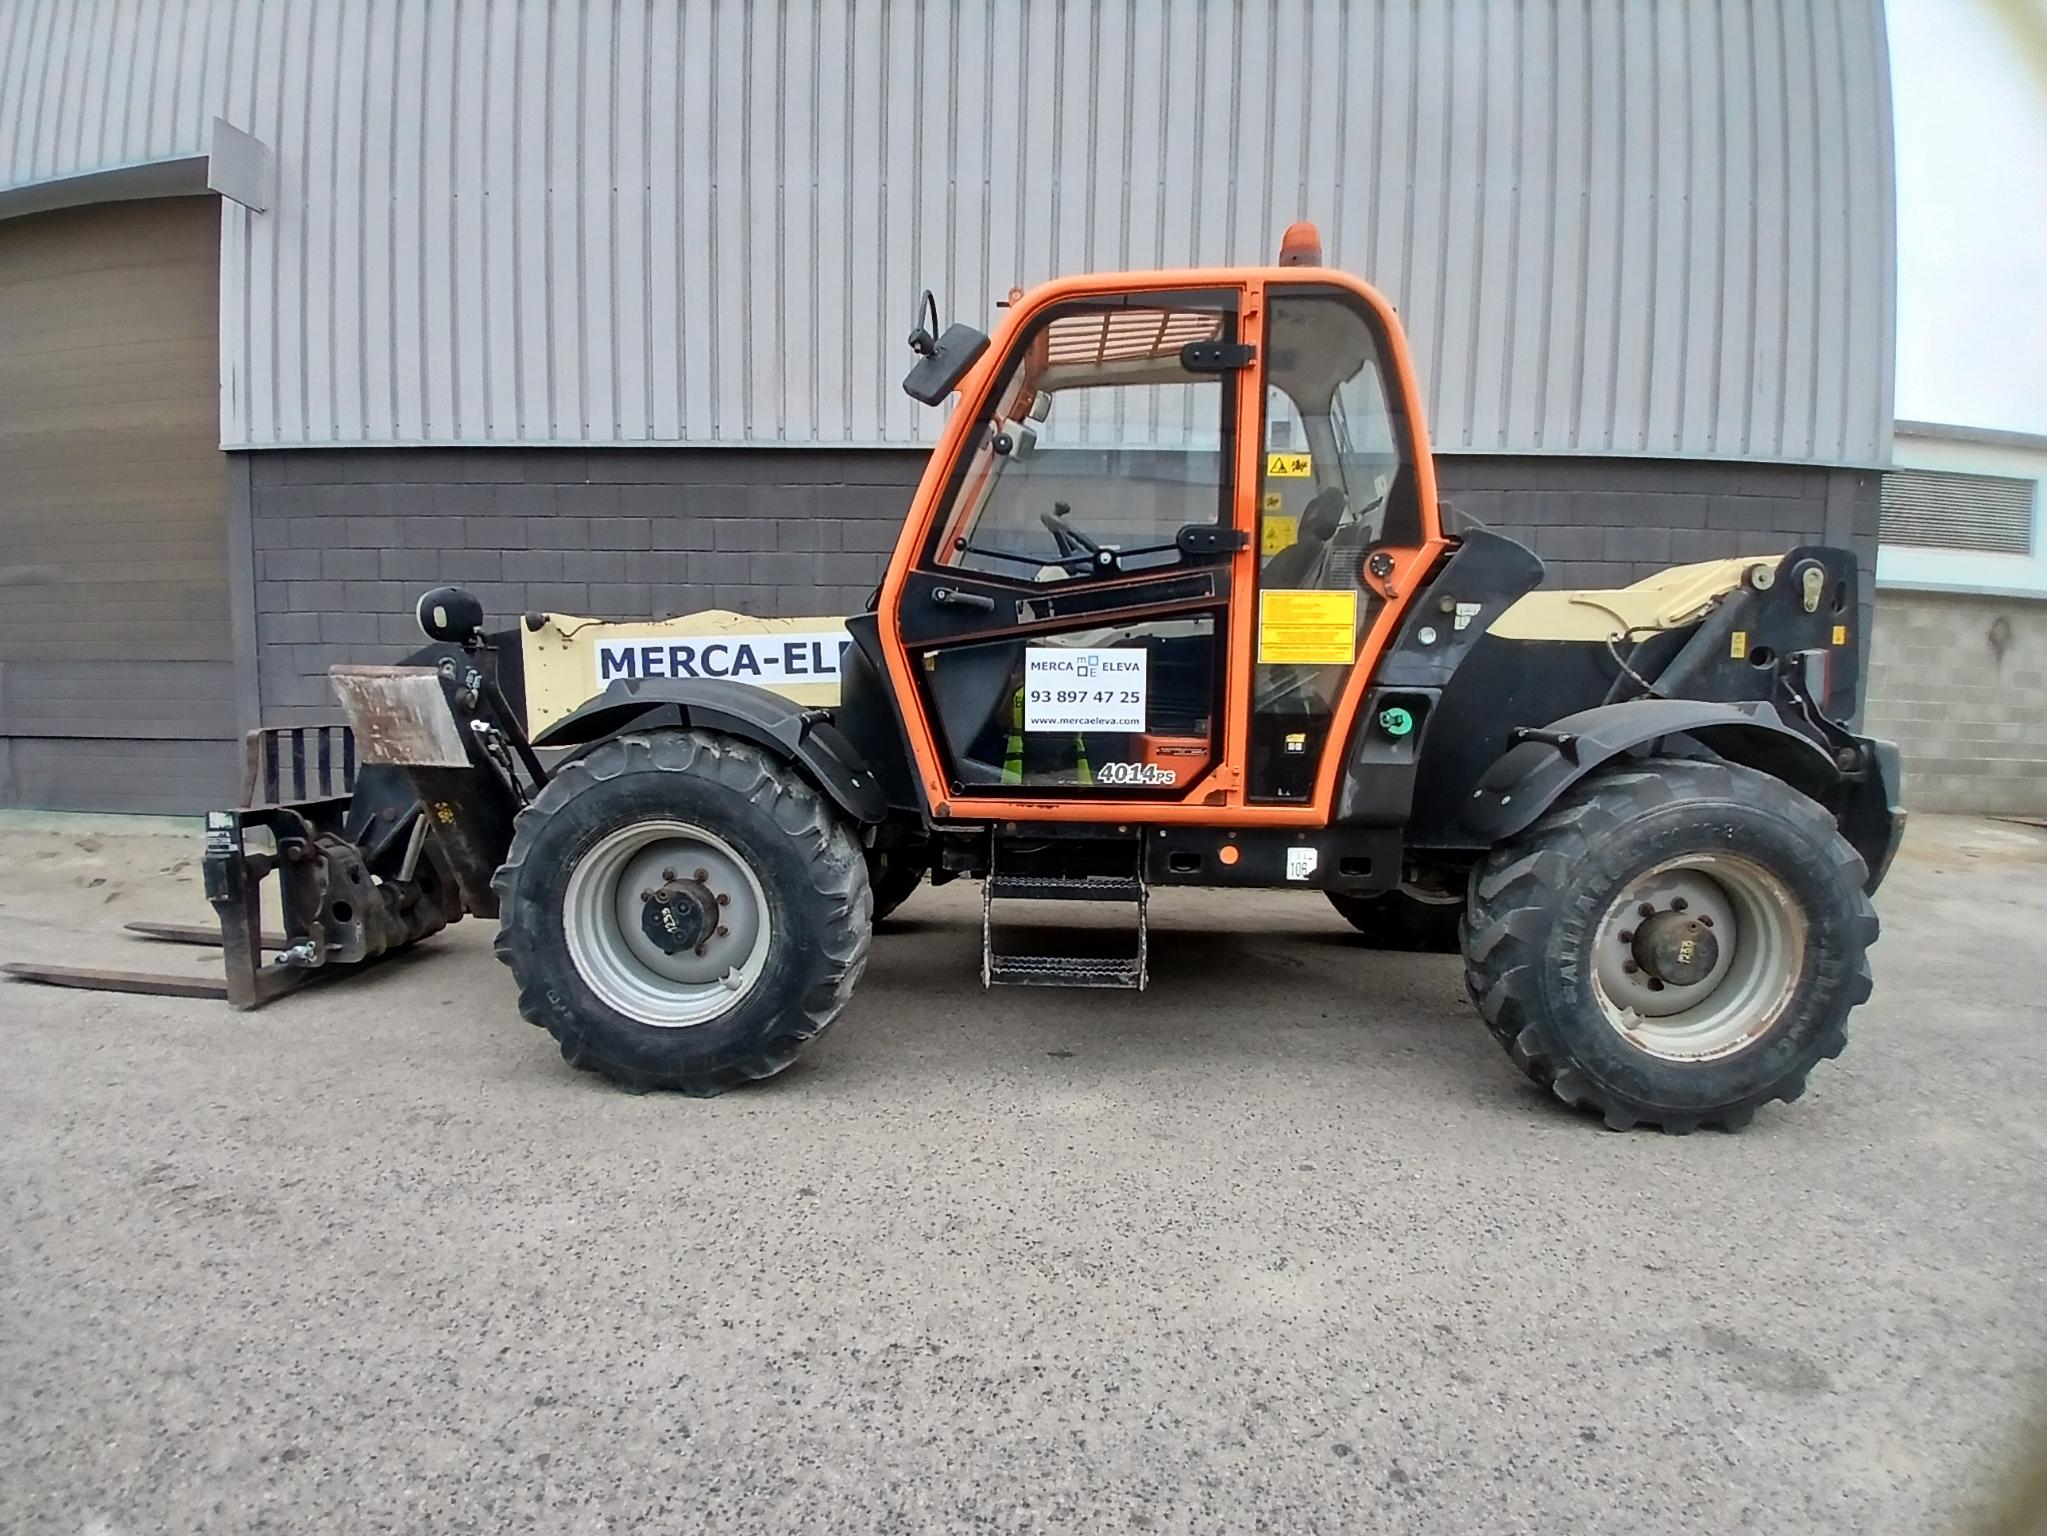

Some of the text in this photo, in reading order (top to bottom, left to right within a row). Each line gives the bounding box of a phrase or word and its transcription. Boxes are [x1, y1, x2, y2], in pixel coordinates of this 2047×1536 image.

[1030, 661, 1140, 672] MERCA ELEVA
[1030, 690, 1140, 704] 93 897 47 25
[1030, 717, 1140, 726] www.mercaeleva.com
